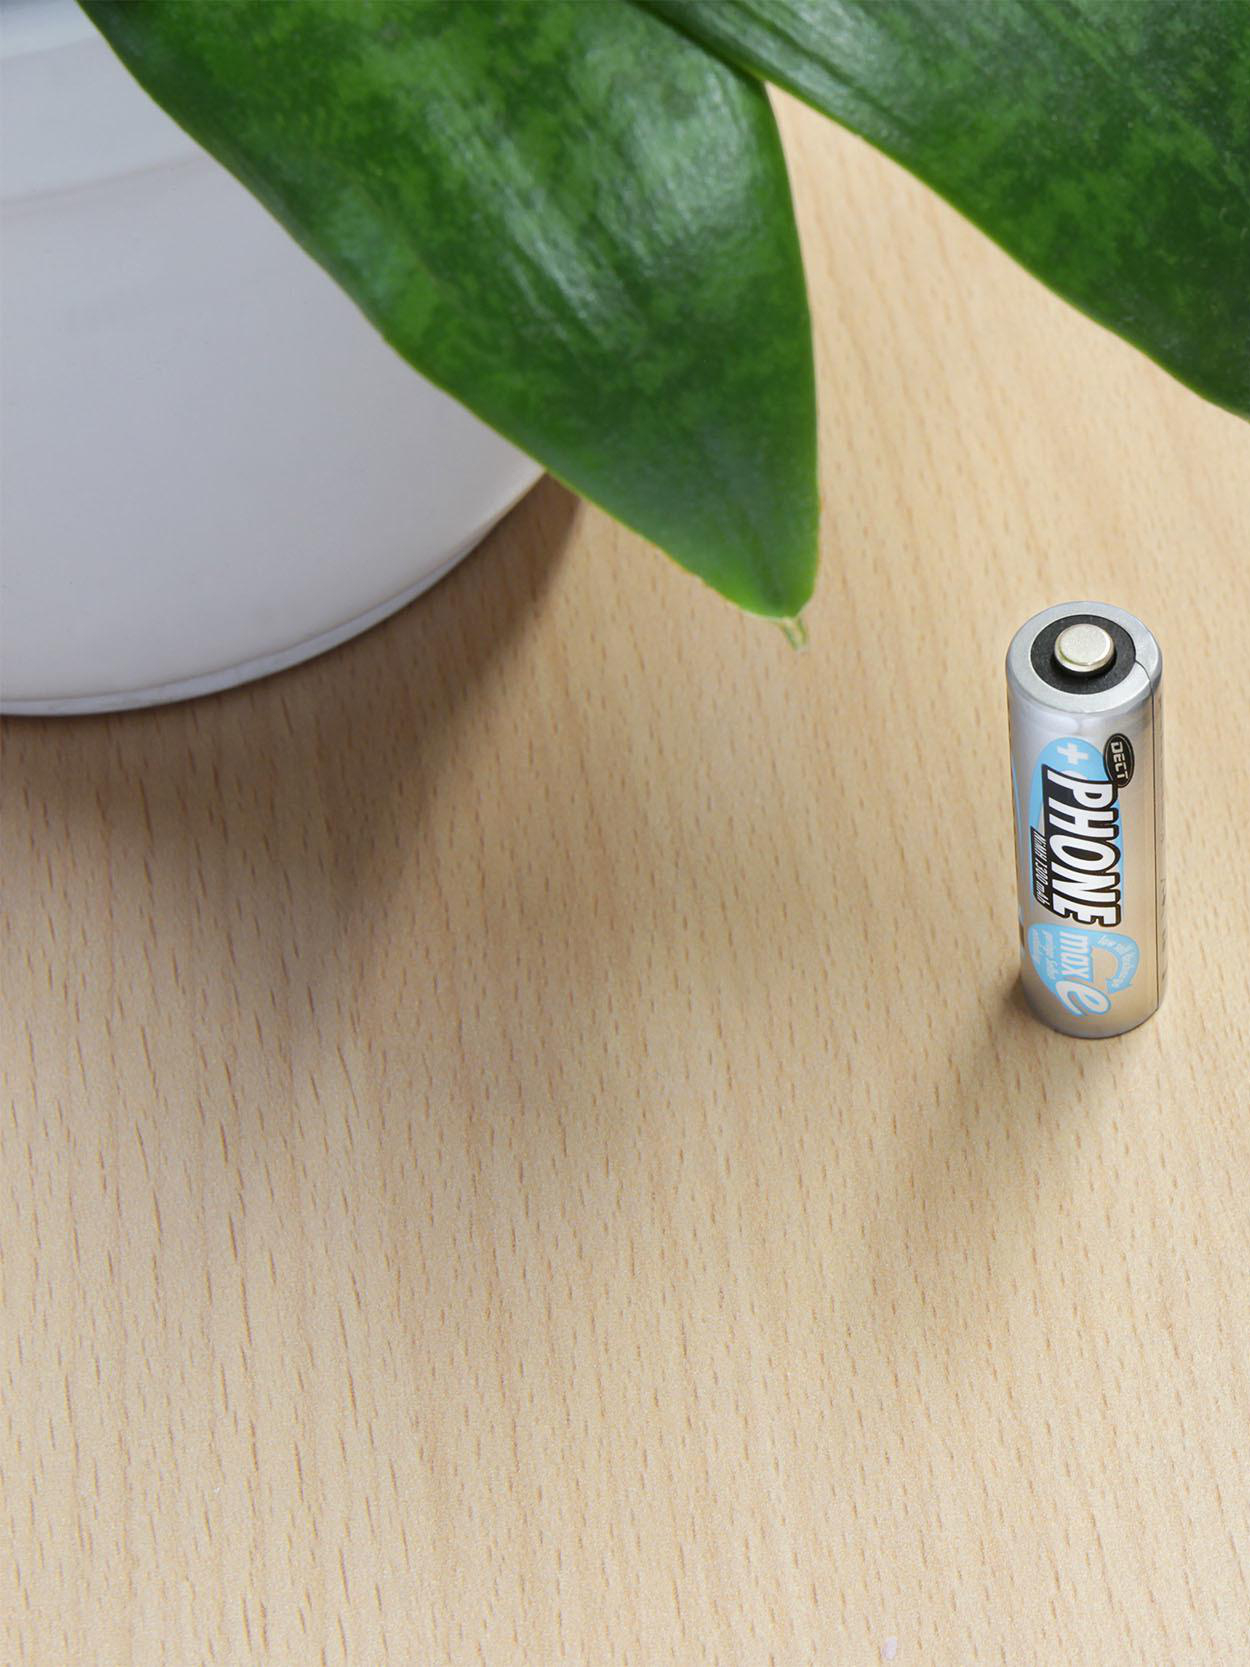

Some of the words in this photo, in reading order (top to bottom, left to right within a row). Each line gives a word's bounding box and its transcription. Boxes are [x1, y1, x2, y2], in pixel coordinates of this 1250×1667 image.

[1110, 740, 1129, 780] DECT
[1046, 768, 1118, 926] PHONE
[1035, 857, 1049, 886] 1300
